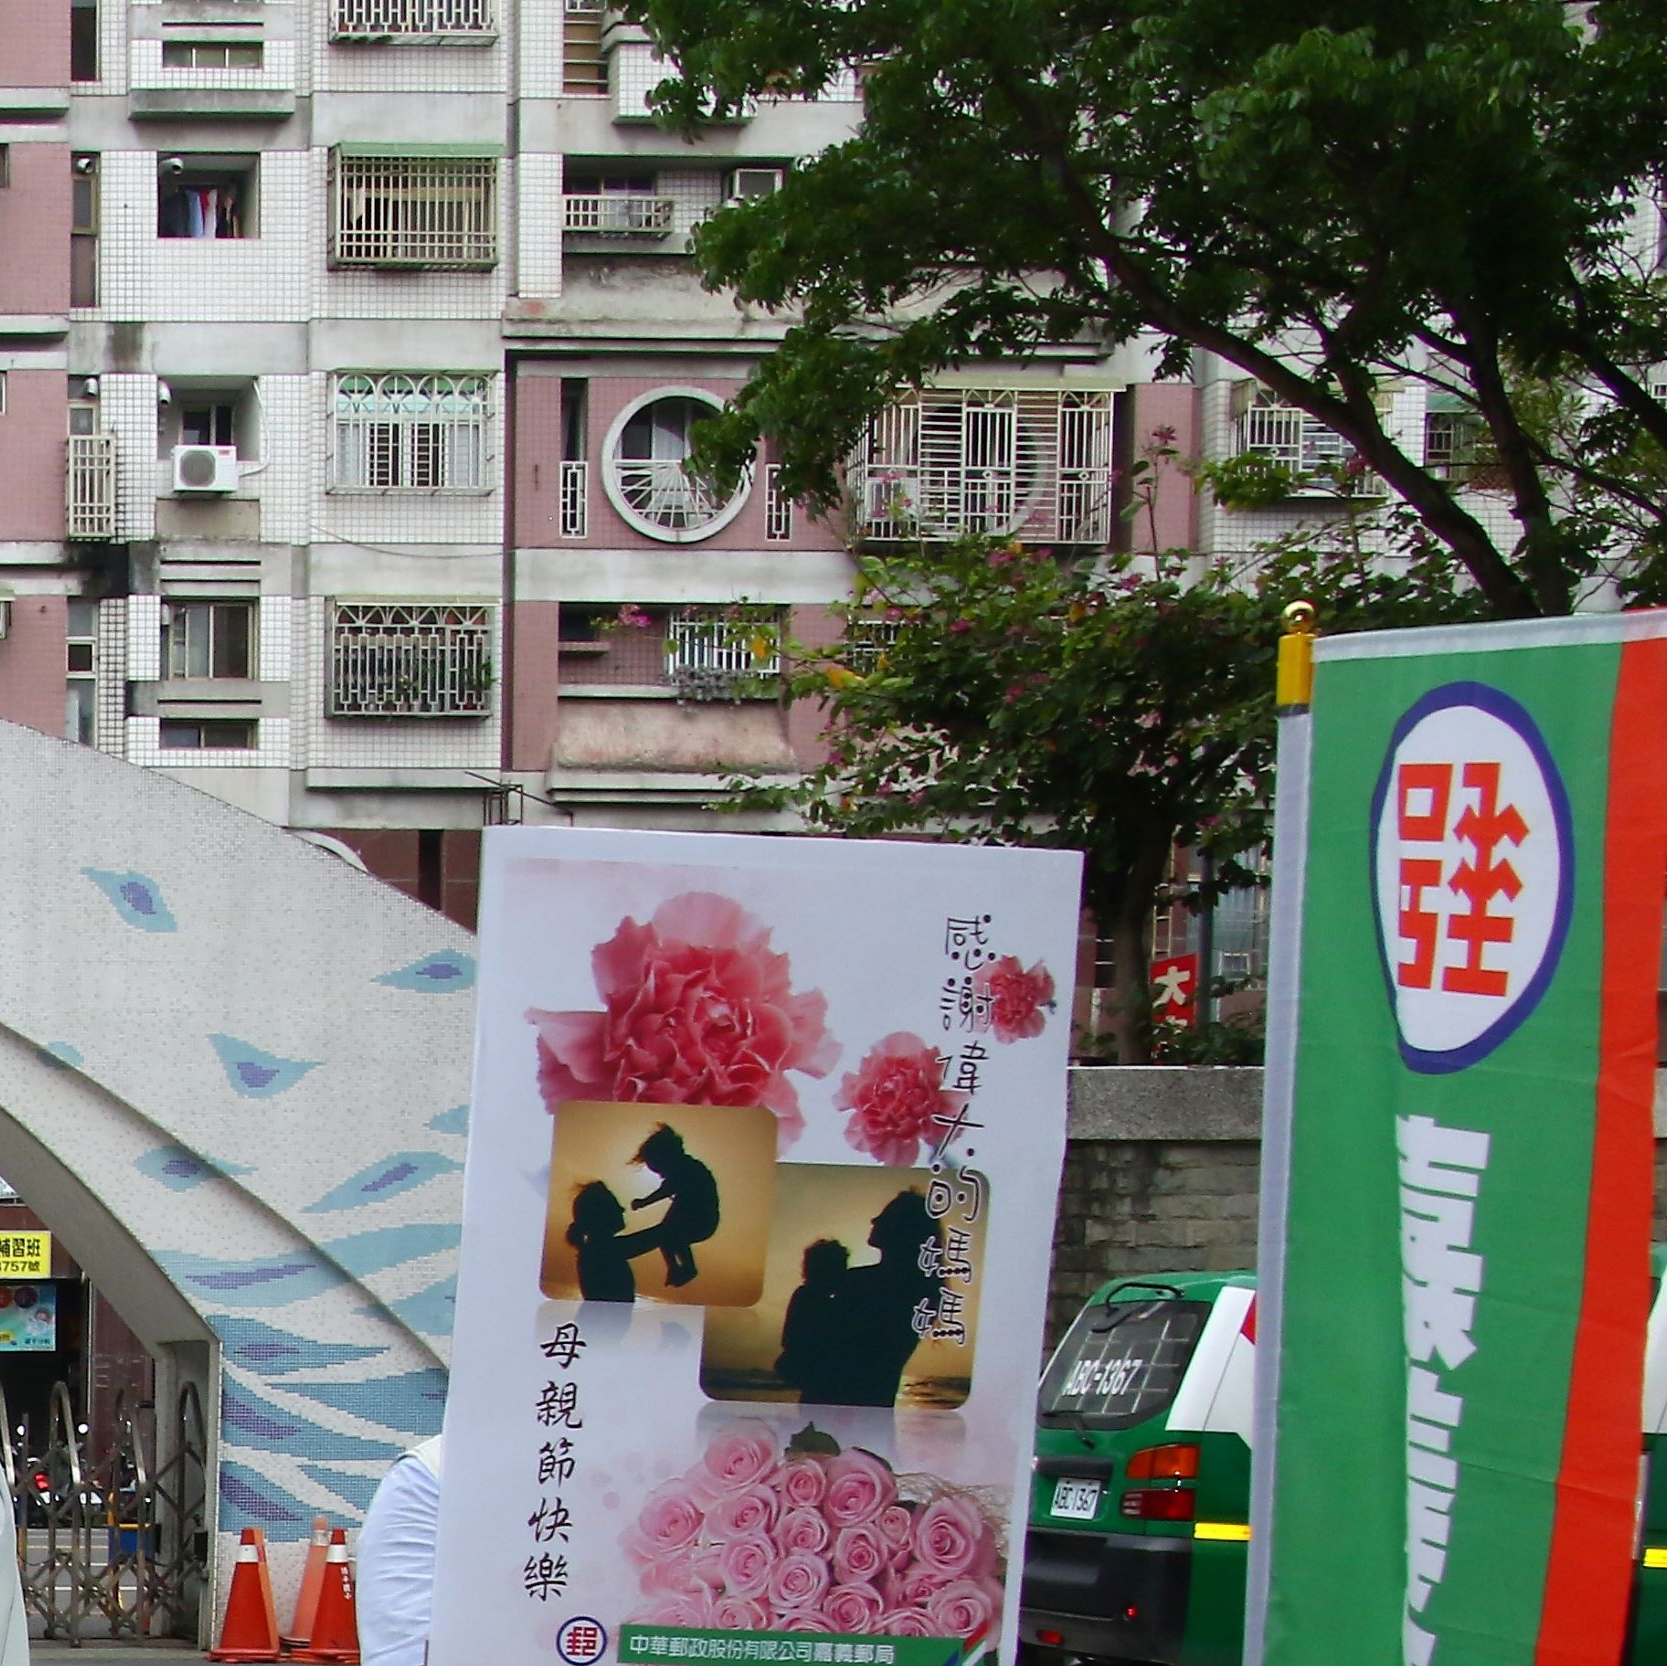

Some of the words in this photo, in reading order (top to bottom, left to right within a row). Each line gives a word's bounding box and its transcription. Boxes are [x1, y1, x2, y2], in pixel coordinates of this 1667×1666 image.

[912, 915, 996, 1346] 感謝偉大的媽媽
[1062, 1359, 1144, 1396] ABC-1367
[523, 1322, 588, 1602] 母親節快樂
[566, 1626, 598, 1657] 郵
[629, 1634, 895, 1665] 中華郵政股份有限公司嘉義郵局
